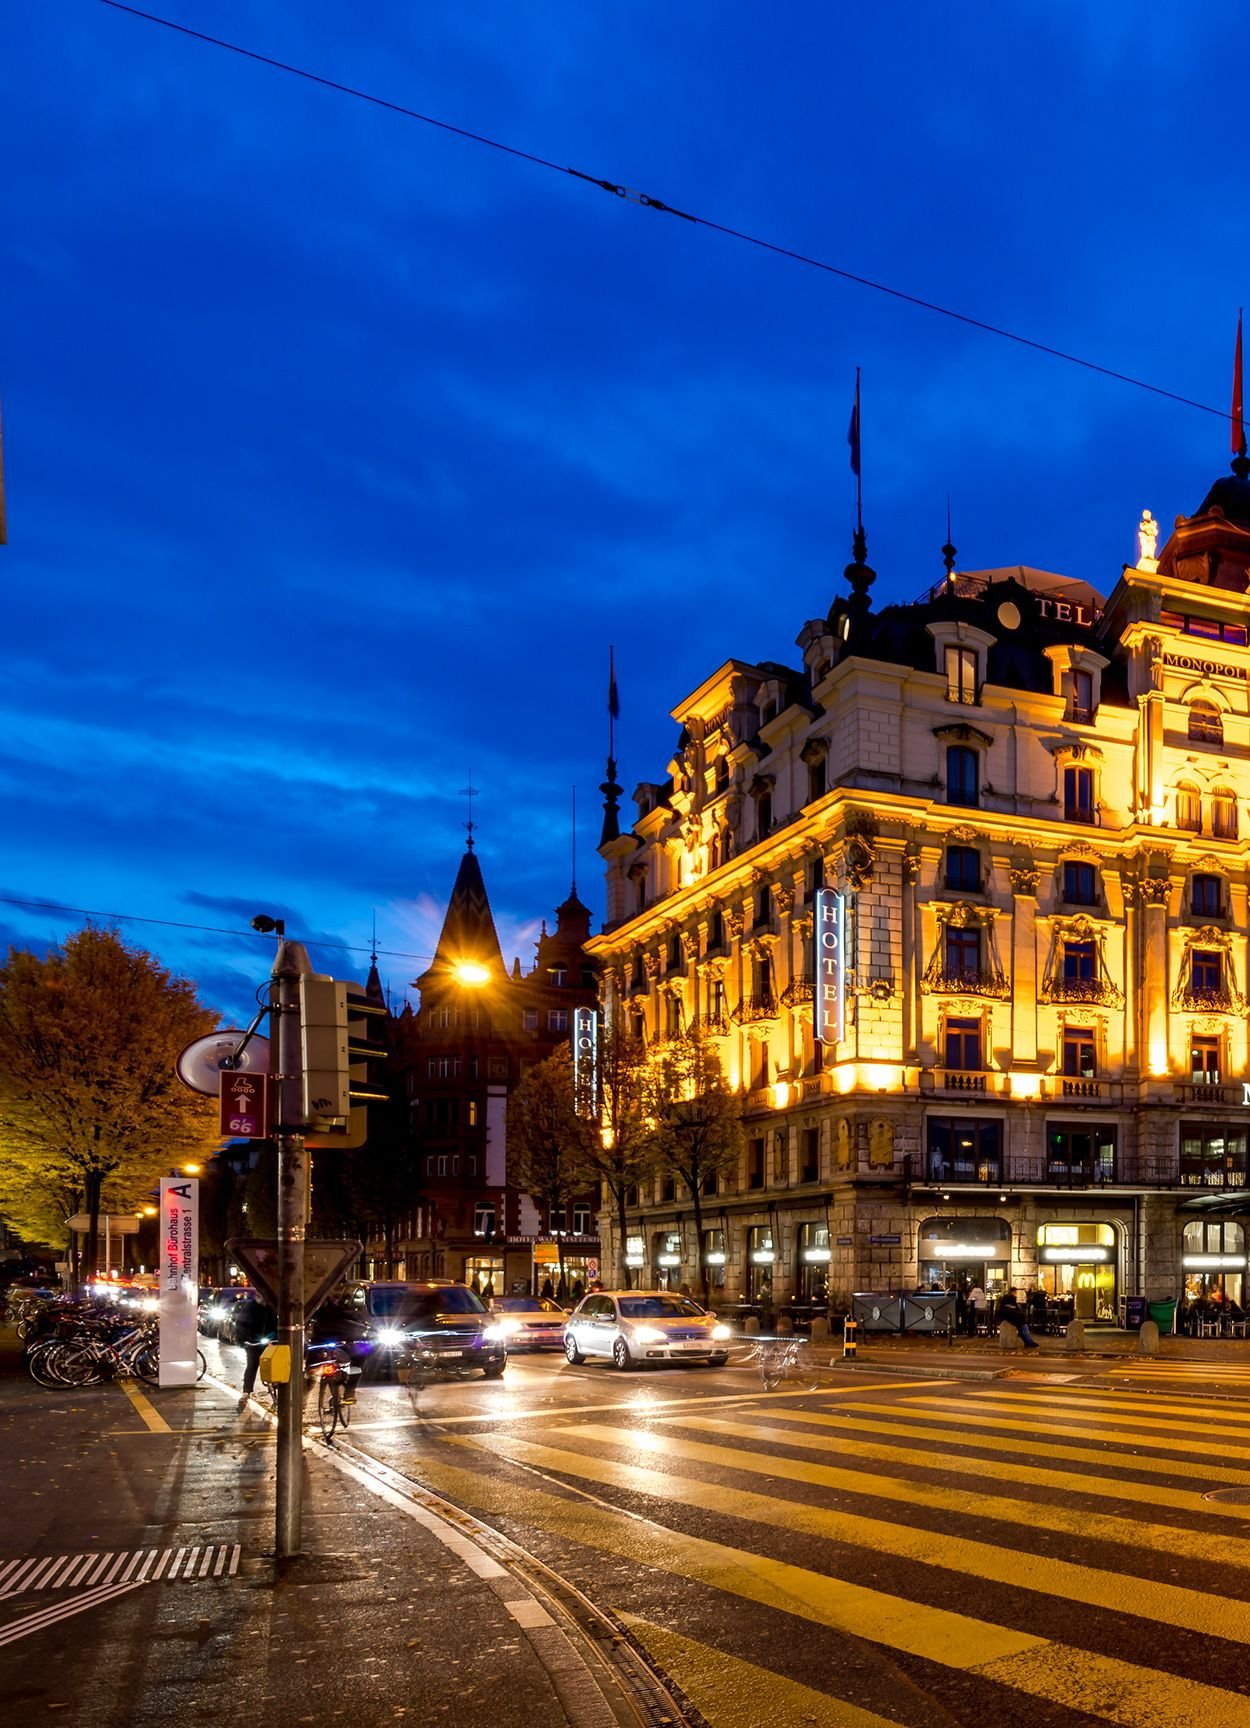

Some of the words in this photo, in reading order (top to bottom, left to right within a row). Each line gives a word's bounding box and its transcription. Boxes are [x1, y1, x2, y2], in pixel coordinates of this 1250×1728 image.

[1035, 598, 1092, 626] TEL
[1166, 653, 1245, 680] MONOPOL
[822, 905, 838, 1027] HOTEL
[168, 1183, 192, 1200] A
[168, 1208, 178, 1251] Bürohaus
